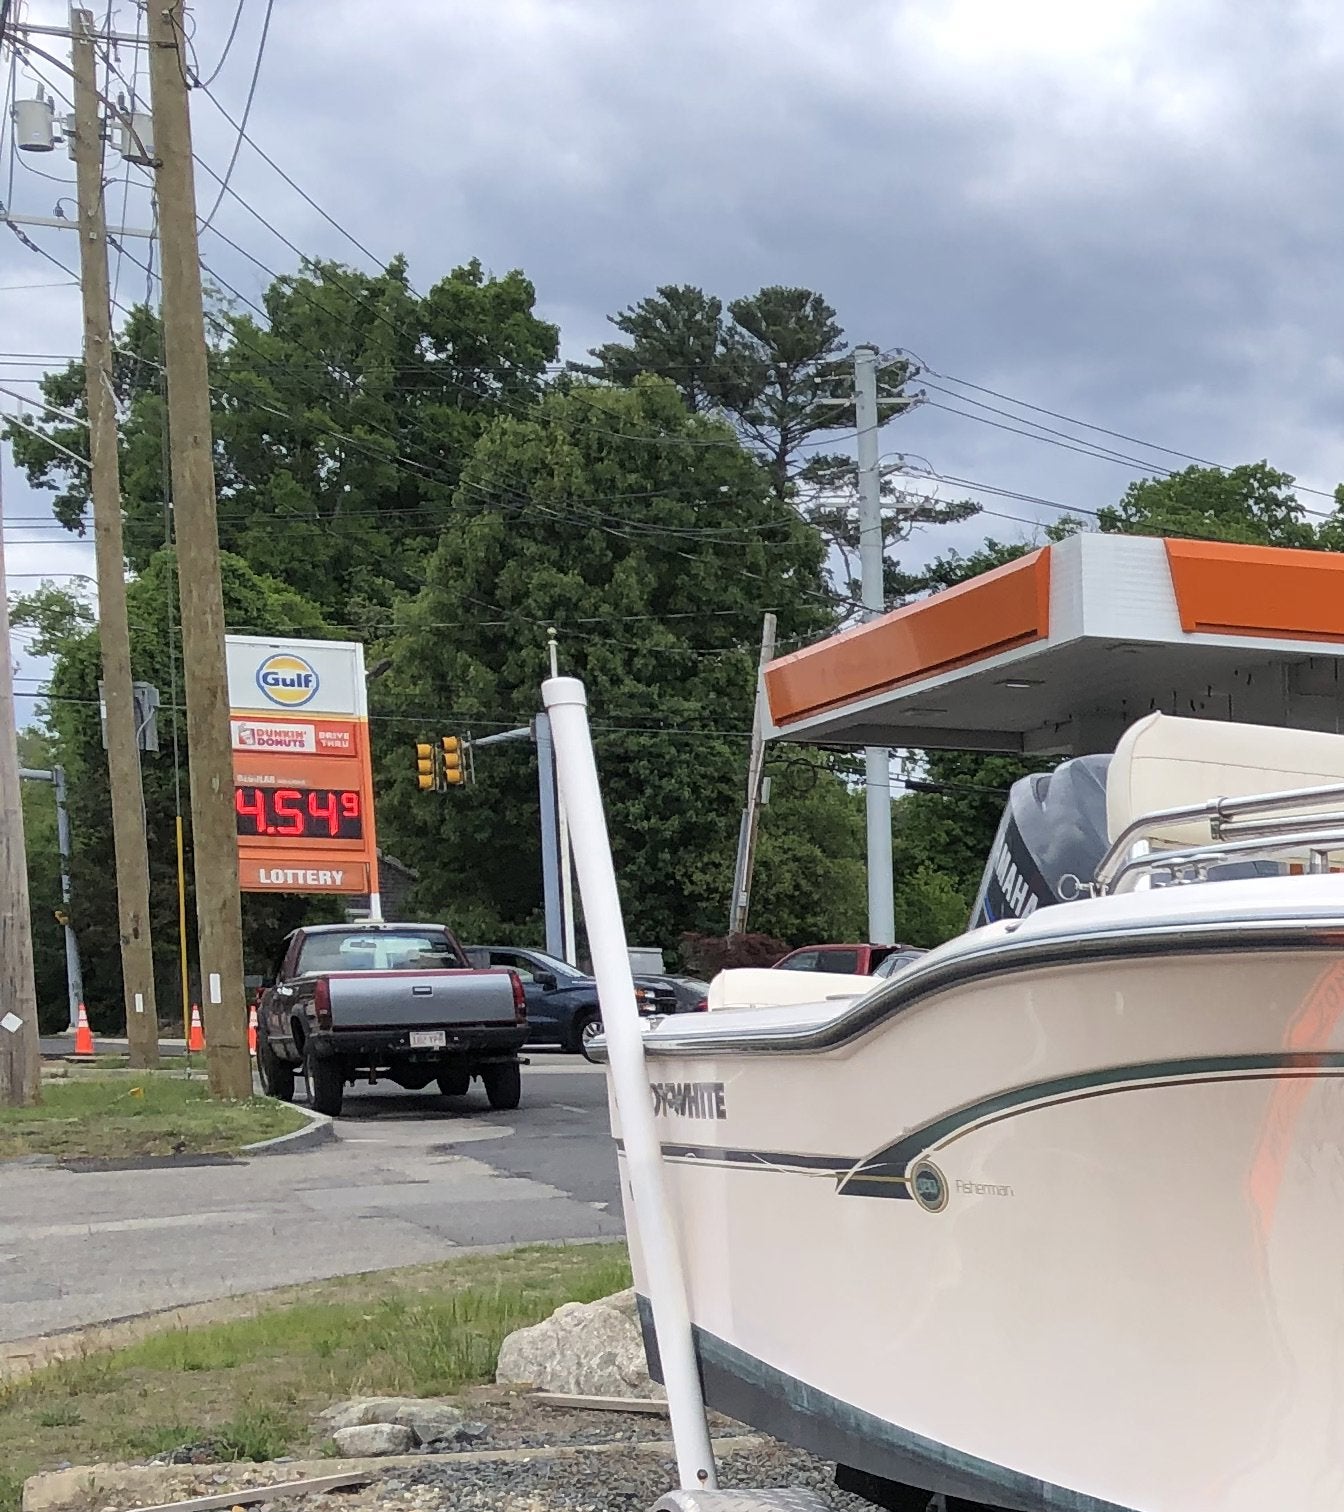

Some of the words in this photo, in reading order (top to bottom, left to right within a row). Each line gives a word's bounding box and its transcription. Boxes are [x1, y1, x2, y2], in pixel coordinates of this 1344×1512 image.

[262, 671, 313, 689] Gulf
[256, 728, 307, 739] DUNKIN'
[319, 731, 350, 740] DRIVE
[257, 738, 305, 748] DONUTS
[320, 740, 350, 748] THRU
[259, 869, 343, 886] LOTTERY
